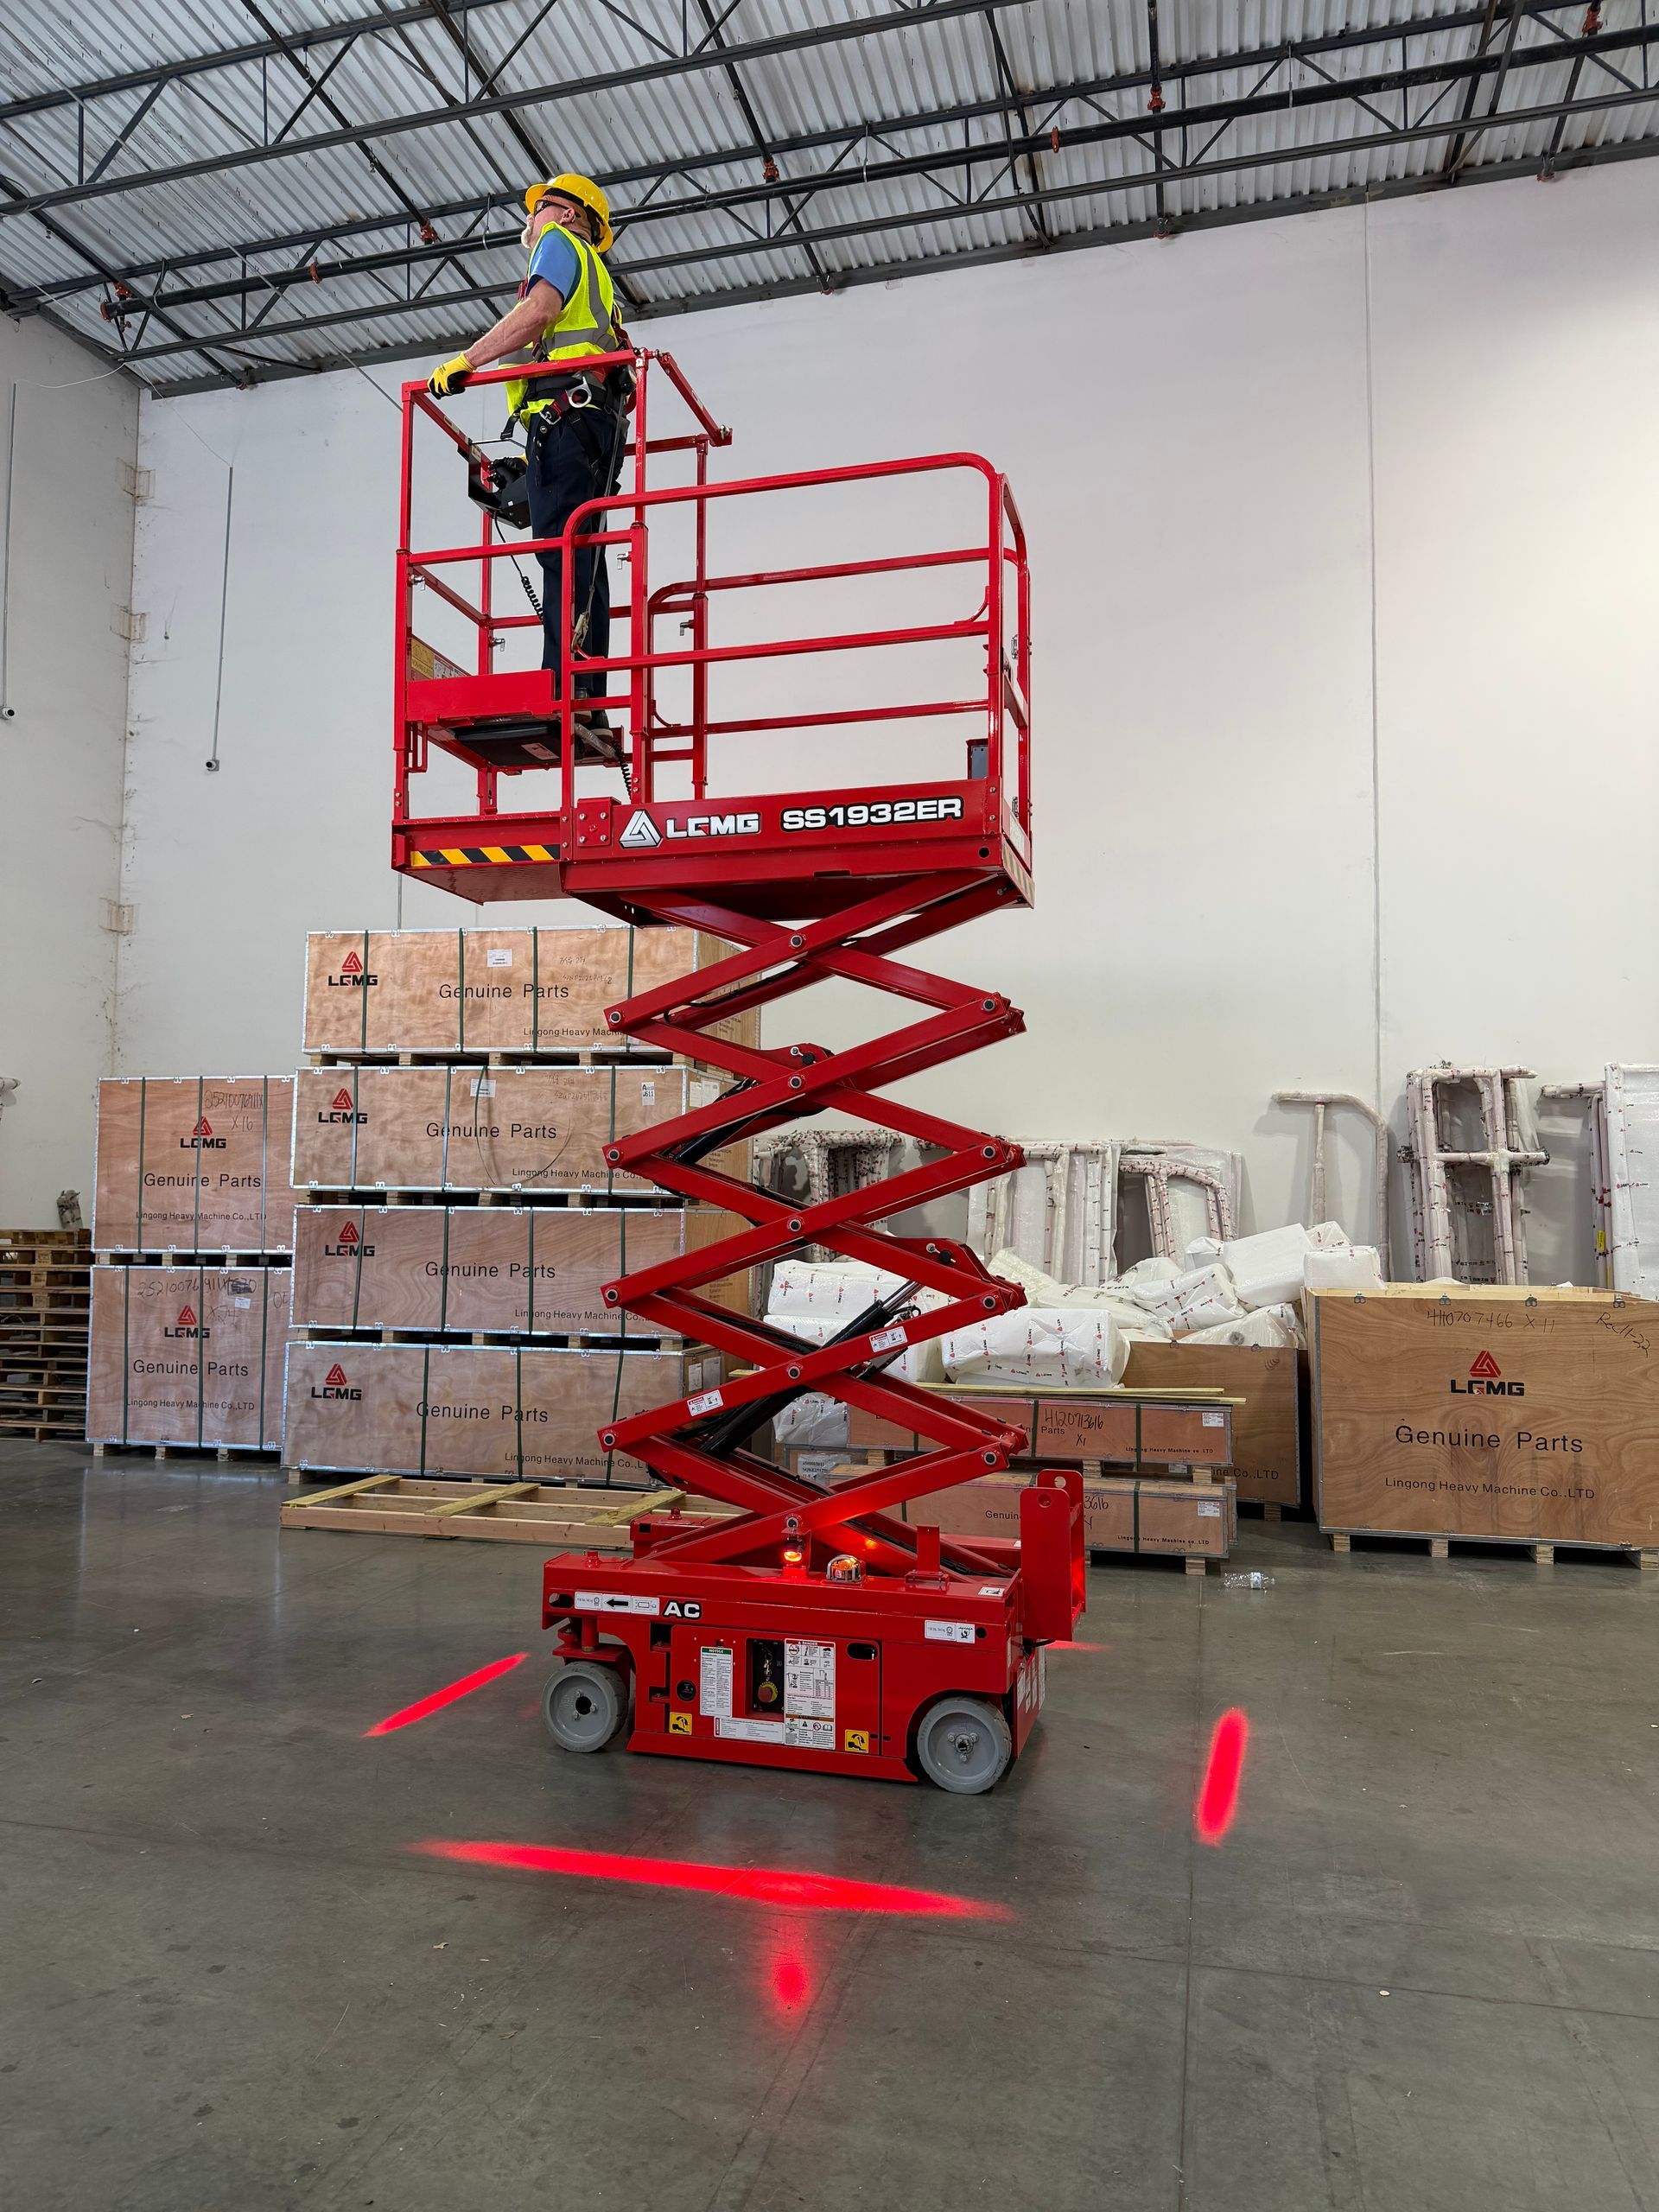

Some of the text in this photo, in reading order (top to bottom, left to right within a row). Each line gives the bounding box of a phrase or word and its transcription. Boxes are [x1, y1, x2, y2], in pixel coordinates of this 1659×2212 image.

[667, 798, 961, 837] LGMG SS1932ER
[328, 975, 378, 987] LGMG
[439, 983, 569, 998] Genuine Parts
[563, 1028, 591, 1037] Heavy
[318, 1112, 368, 1123] LGMG
[427, 1122, 557, 1139] Genuine Parts
[180, 1137, 226, 1149] LGMG
[512, 1168, 549, 1179] Lingong
[550, 1169, 581, 1179] Heavy
[143, 1173, 261, 1188] Genuine Parts
[137, 1211, 168, 1221] Lngong
[169, 1211, 194, 1221] Heavy
[325, 1244, 375, 1256] LGMG
[425, 1262, 556, 1279] Genuine Parts
[515, 1308, 551, 1319] Linong
[553, 1310, 582, 1320] Heavy
[584, 1311, 622, 1320] Machine
[164, 1327, 210, 1338] LGMG
[133, 1359, 249, 1376] Genuine Parts
[311, 1386, 362, 1401] LGMG
[1450, 1379, 1524, 1396] LGMG
[160, 1399, 185, 1408] Heavy
[187, 1400, 219, 1409] Mahine
[416, 1402, 548, 1422] Genuine Parts
[1041, 1426, 1065, 1434] Parts
[1395, 1425, 1583, 1453] Genuine Parts
[544, 1455, 574, 1466] Heavy
[1386, 1478, 1435, 1491] Lingong
[1440, 1480, 1479, 1495] Heavy
[1483, 1483, 1536, 1497] Machine
[985, 1510, 1020, 1519] Genuin
[664, 1602, 700, 1618] AC
